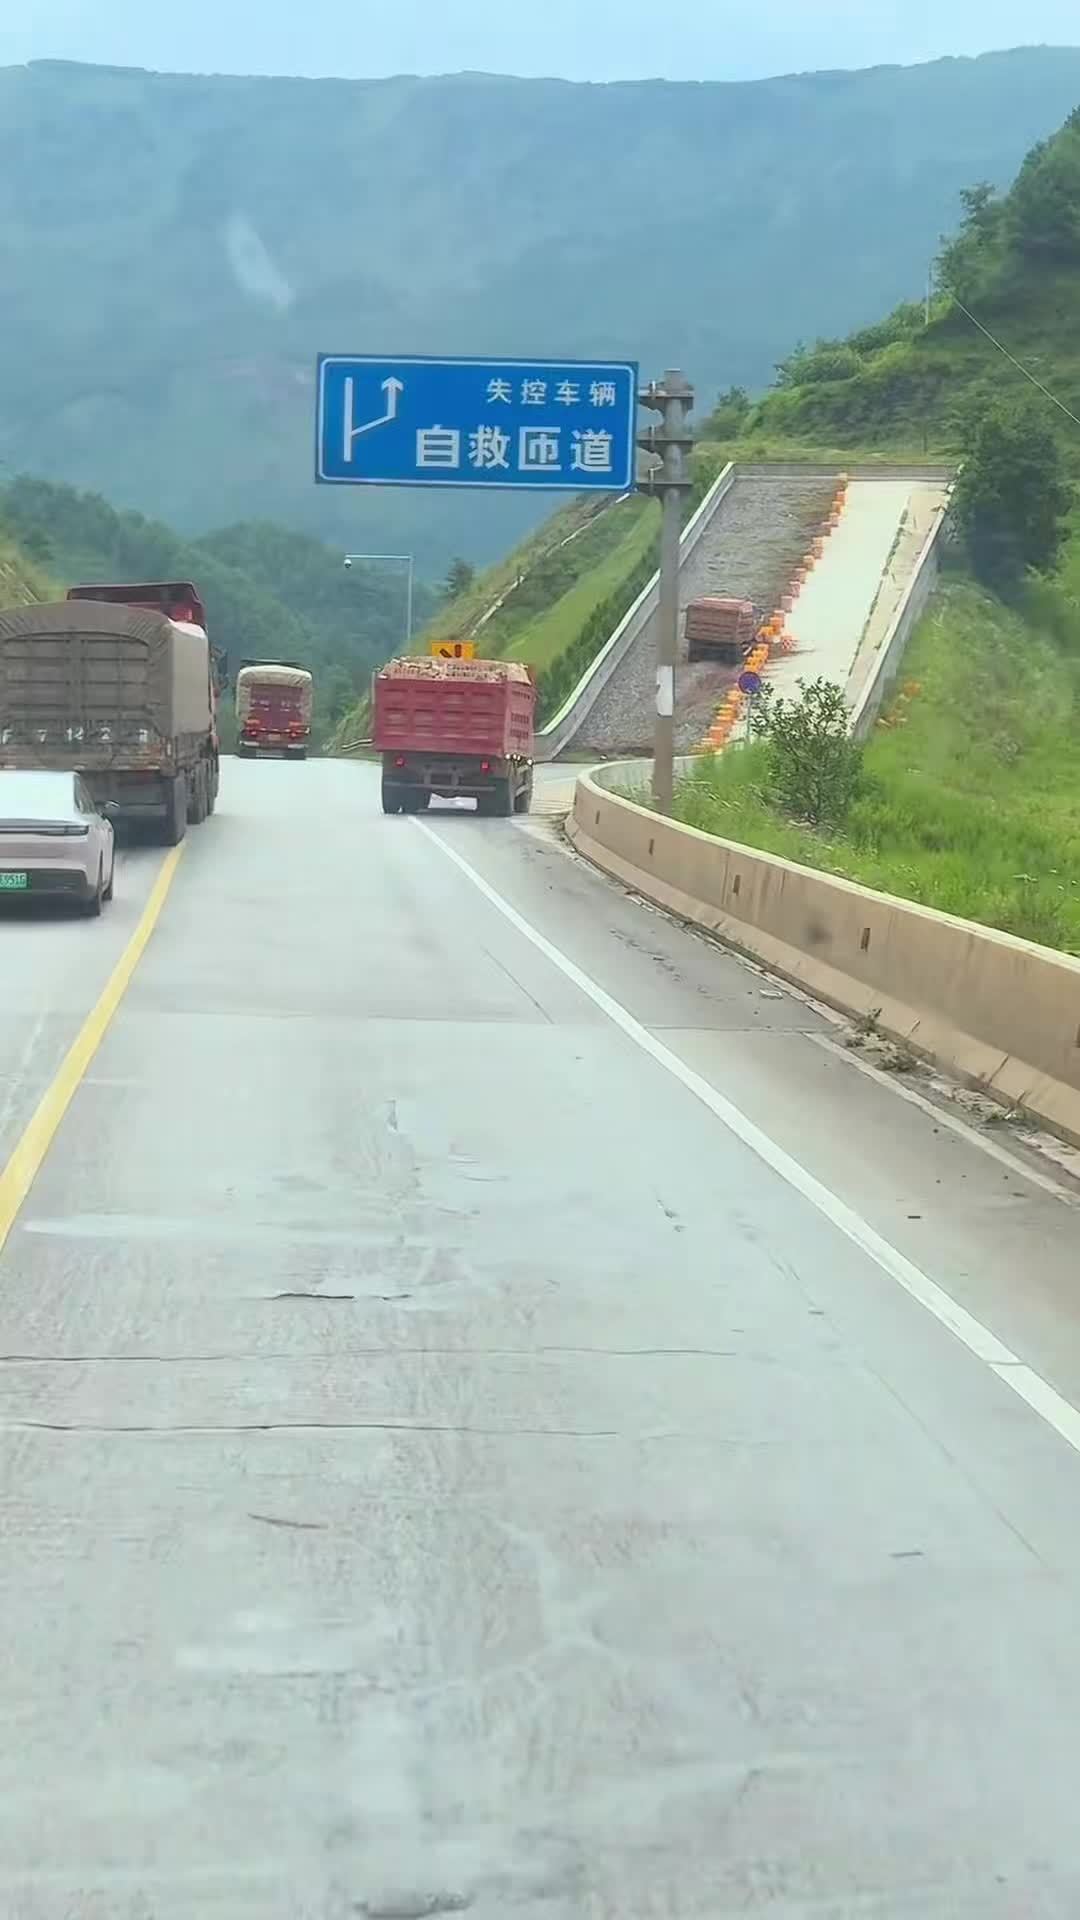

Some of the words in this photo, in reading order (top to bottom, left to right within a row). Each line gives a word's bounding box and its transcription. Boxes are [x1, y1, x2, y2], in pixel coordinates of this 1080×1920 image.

[486, 378, 617, 407] 失控车辆
[415, 424, 613, 472] 自救匝道
